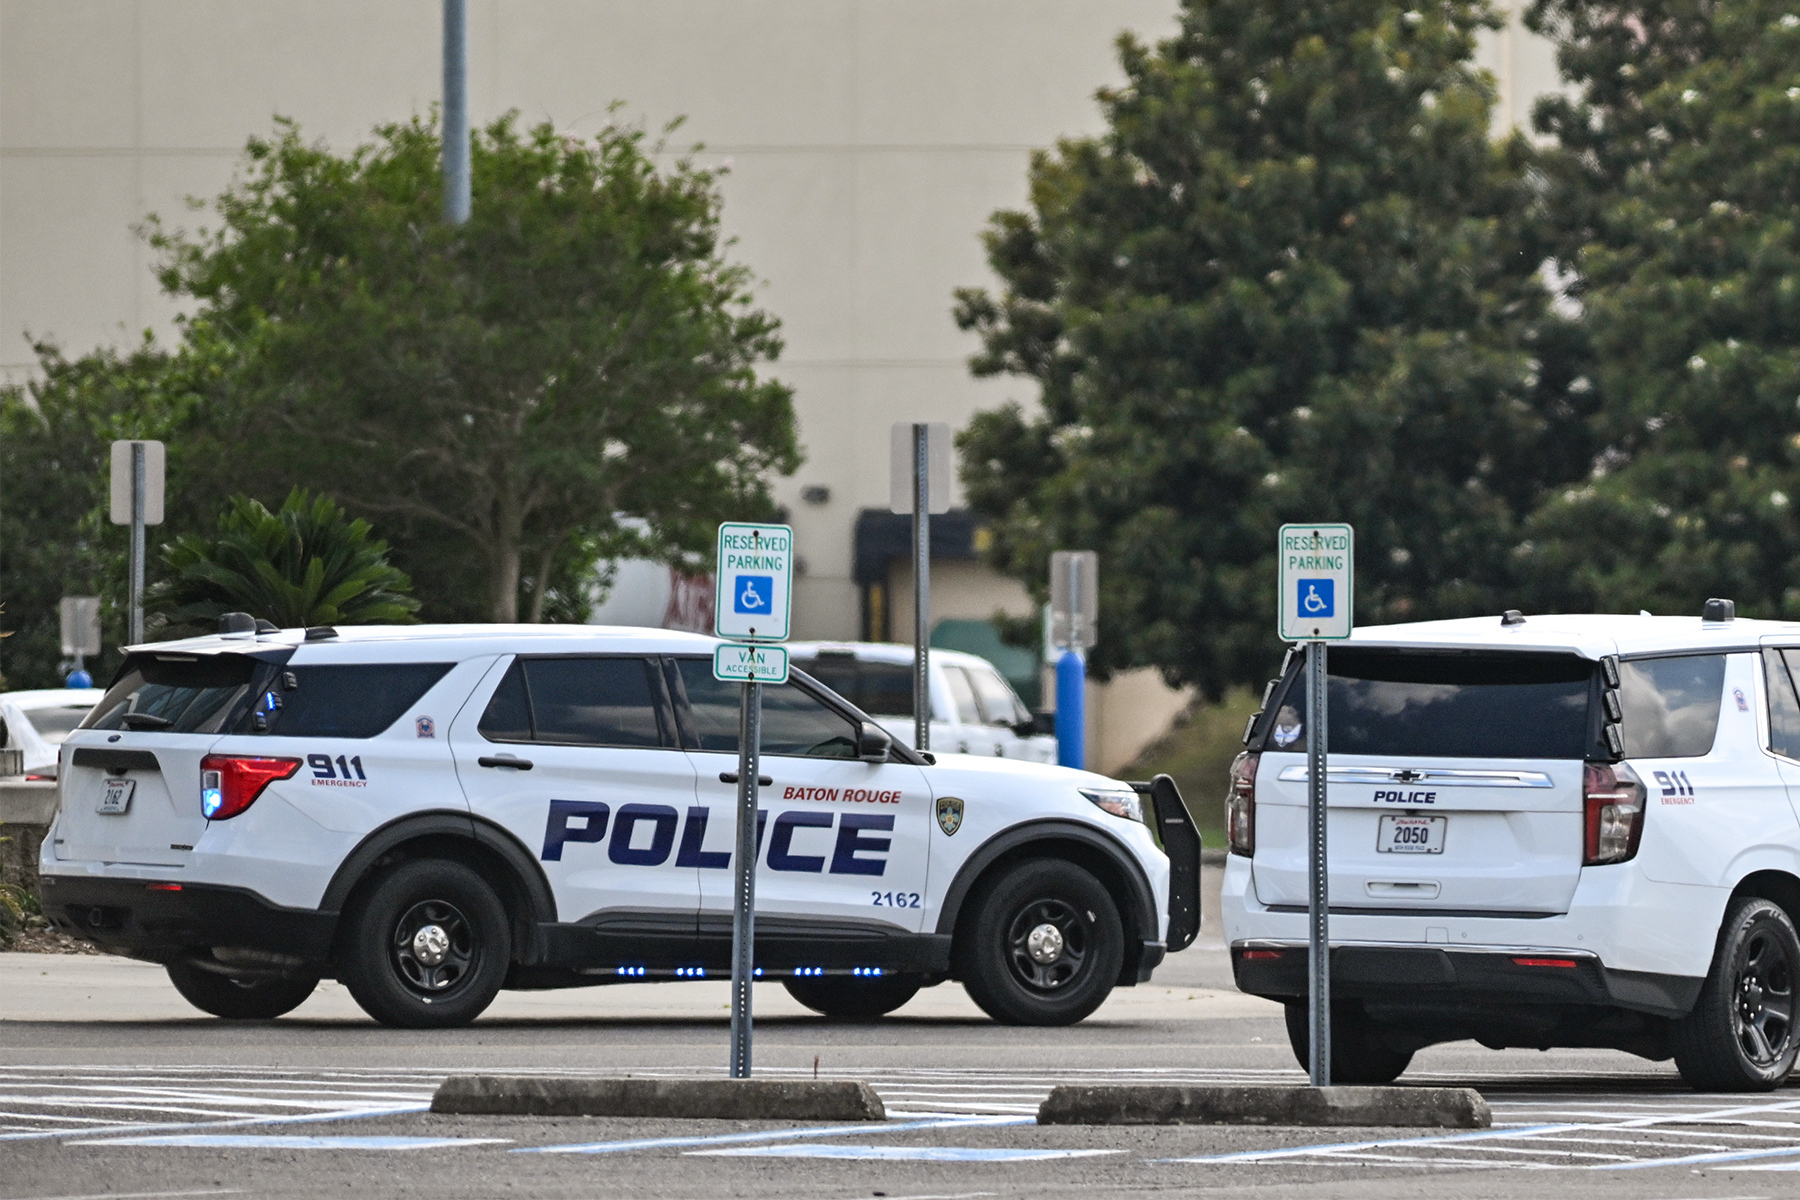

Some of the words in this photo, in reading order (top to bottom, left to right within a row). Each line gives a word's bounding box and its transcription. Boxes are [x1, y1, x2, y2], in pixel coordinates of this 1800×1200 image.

[724, 534, 788, 552] RESERVED
[1285, 536, 1347, 551] RESERVED
[727, 554, 783, 572] PARKING
[1289, 556, 1343, 571] PARKING
[739, 651, 766, 664] VAN
[726, 664, 777, 676] ACCESSIBLE
[307, 753, 367, 780] 911
[311, 779, 368, 788] EMERGENCY
[1652, 770, 1694, 796] 911
[783, 787, 839, 802] BATON
[842, 789, 902, 804] ROUGE
[1373, 790, 1437, 804] POLICE
[1393, 826, 1429, 844] 2050
[871, 891, 921, 909] 2162
